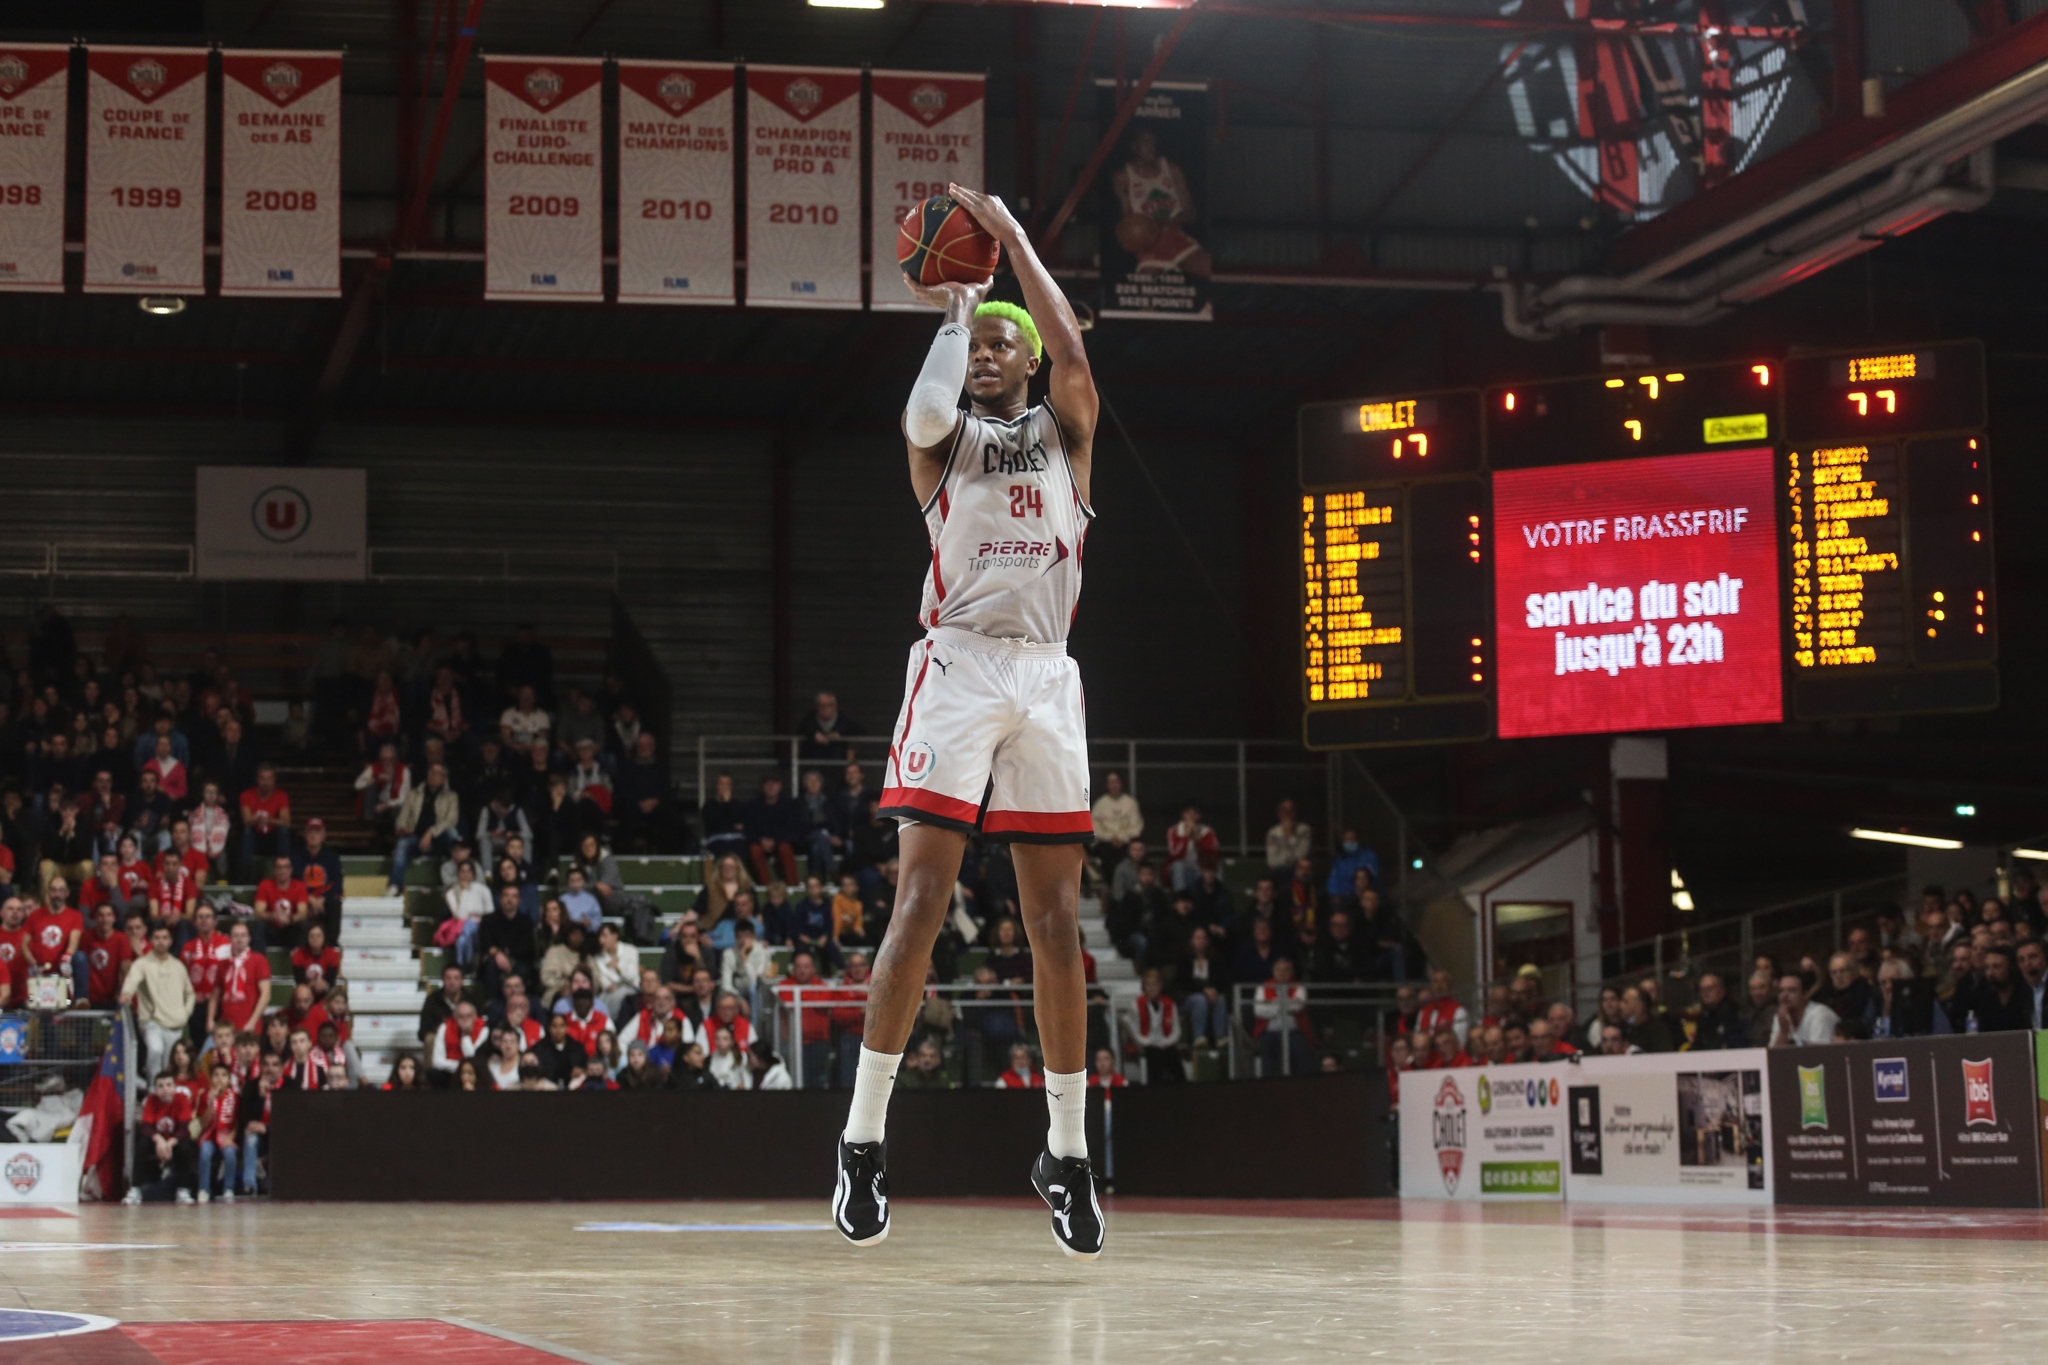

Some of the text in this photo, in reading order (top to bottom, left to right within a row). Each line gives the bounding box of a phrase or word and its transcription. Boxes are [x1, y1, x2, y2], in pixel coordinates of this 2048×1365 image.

[103, 108, 191, 124] COUPE DE
[238, 113, 326, 127] SEMAINE
[108, 125, 184, 140] FRANCE
[499, 117, 589, 133] FINALISTE
[628, 122, 726, 138] MATCH DES
[250, 129, 312, 143] DES AS
[517, 136, 571, 149] EURO-
[755, 127, 851, 142] CHAMPION
[885, 132, 972, 147] FINALISTE
[624, 137, 729, 152] CHAMPIONS
[779, 145, 851, 159] FRANCE
[493, 152, 595, 167] CHALLENGE
[897, 149, 959, 164] PRO A
[773, 160, 835, 175] PRO A
[110, 188, 182, 208] 1999
[895, 182, 951, 200] 198
[245, 190, 317, 211] 2008
[508, 195, 580, 217] 2009
[641, 200, 712, 221] 2010
[769, 204, 839, 226] 2010
[1359, 400, 1418, 432] CHOLET
[1009, 485, 1043, 518] 24
[265, 500, 296, 531] U
[968, 555, 1040, 571] Transports
[1525, 572, 1744, 629] service du soir
[1554, 620, 1725, 677] jusqu'à 23h
[907, 751, 926, 773] U
[1877, 1069, 1904, 1090] Kyriad
[1968, 1077, 1990, 1103] ibis
[1431, 1108, 1467, 1150] CHOLET
